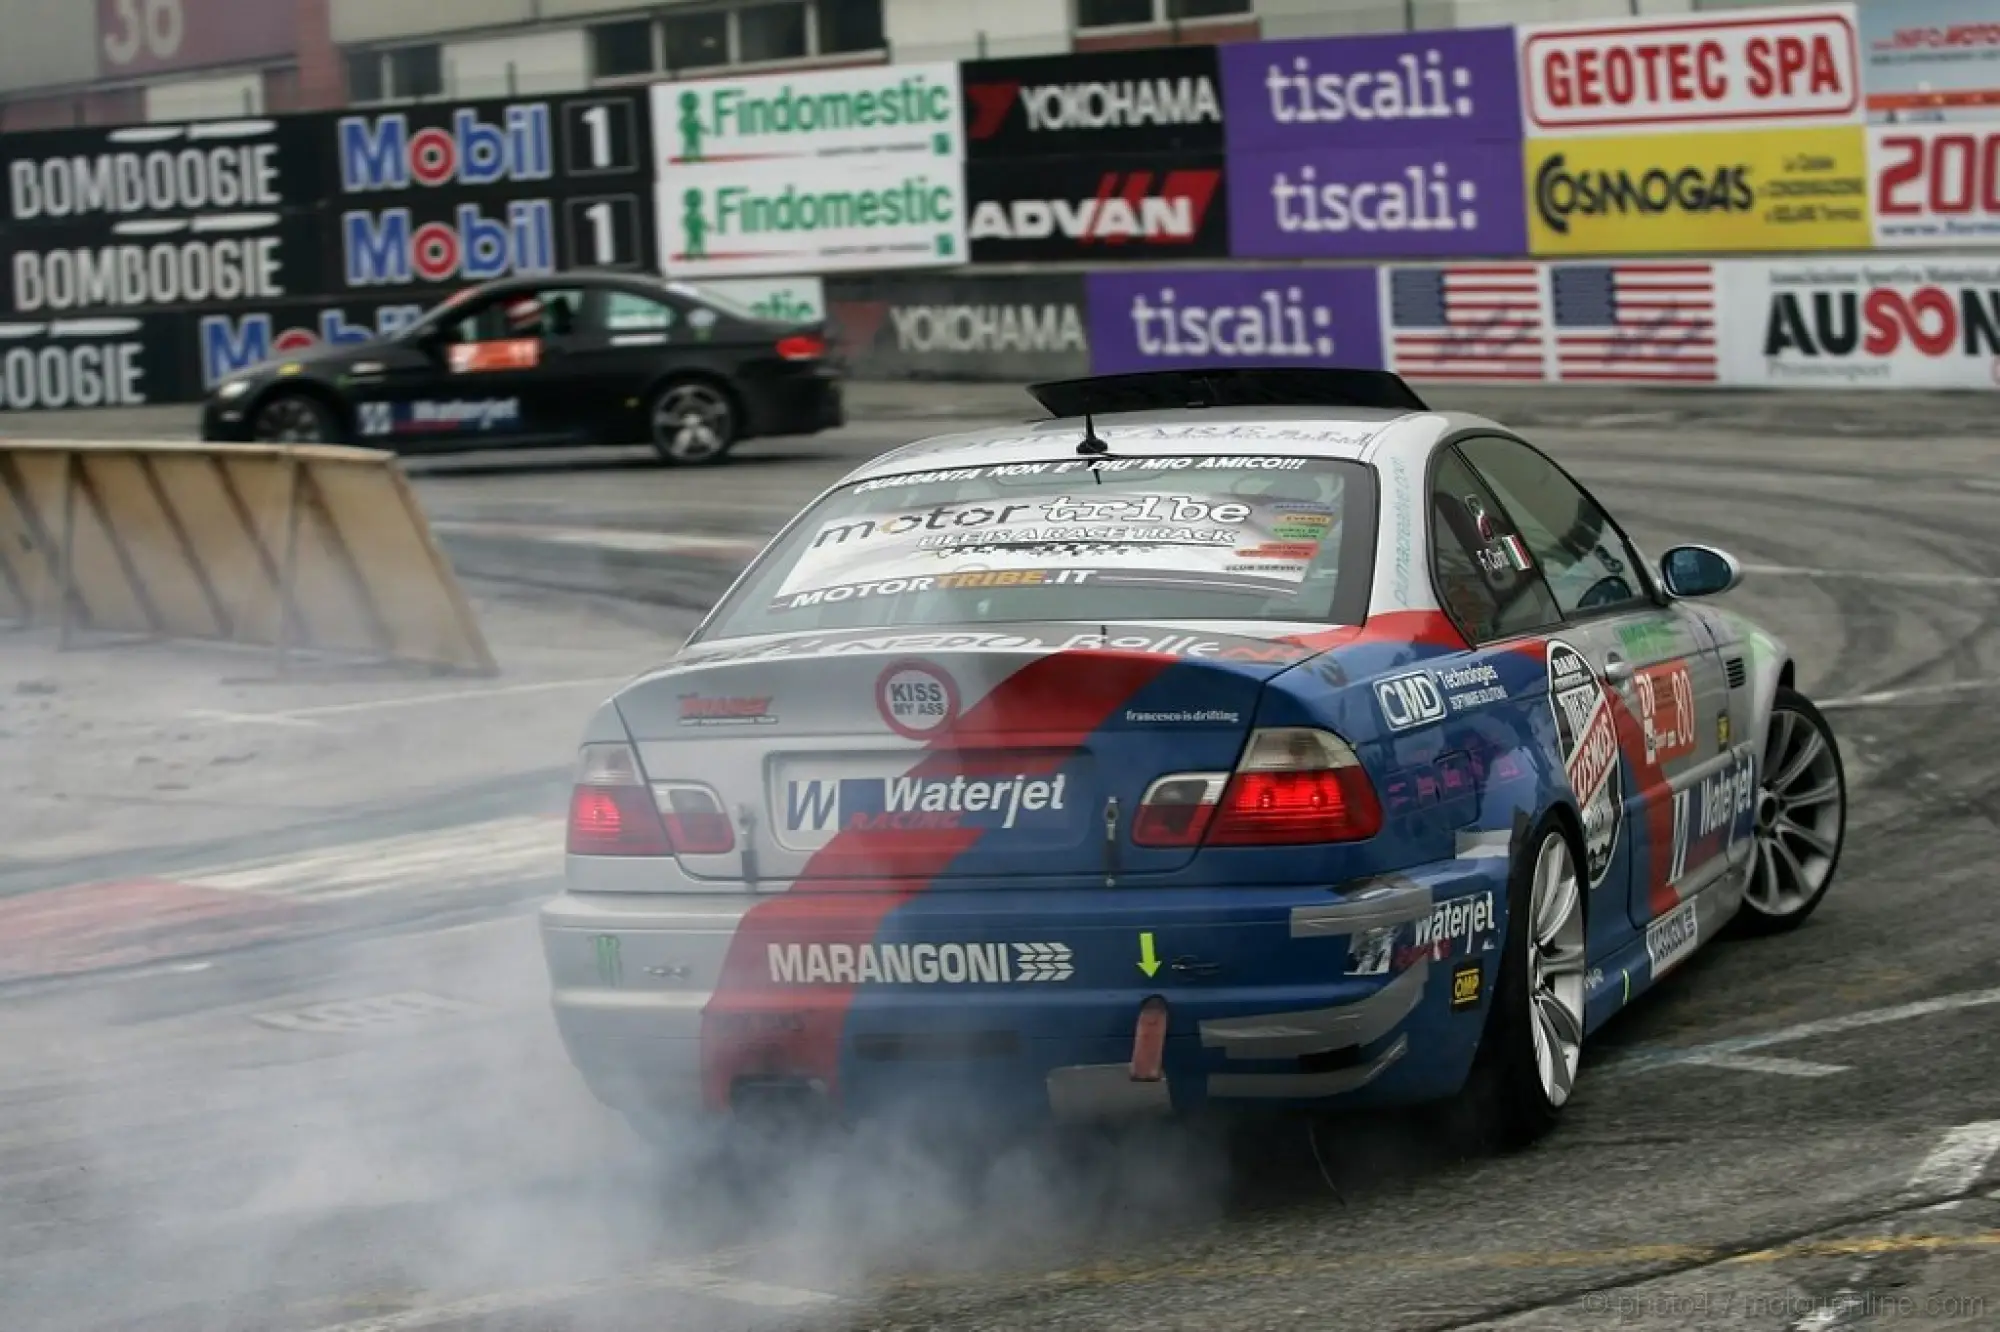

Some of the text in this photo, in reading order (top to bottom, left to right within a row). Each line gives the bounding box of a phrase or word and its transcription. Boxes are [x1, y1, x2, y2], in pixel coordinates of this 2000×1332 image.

[1544, 36, 1841, 107] GEOTEC SPA
[711, 75, 951, 138] Findomestic
[1020, 76, 1223, 129] YOKOHAMA
[338, 102, 612, 192] Mobil 1
[11, 143, 282, 219] BOMBOOGIE
[714, 176, 953, 238] Findomestic
[1536, 153, 1755, 234] COSMOGAS
[343, 199, 614, 285] Mobil 1
[970, 197, 1193, 239] ADVAN
[14, 237, 284, 311] BOMBOOGIE
[890, 303, 1086, 353] YOKOHAMA
[0, 342, 147, 409] OOGIE
[985, 463, 1049, 478] NON
[1138, 457, 1192, 470] MIO
[1196, 456, 1306, 470] AMICO!!!
[813, 496, 1252, 548] motor tribe
[890, 683, 942, 702] KISS
[1380, 675, 1440, 726] CMD
[1436, 661, 1498, 690] Technologies
[893, 703, 945, 716] MY ASS
[884, 774, 1066, 829] Waterjet
[767, 941, 1010, 984] MARANGONI
